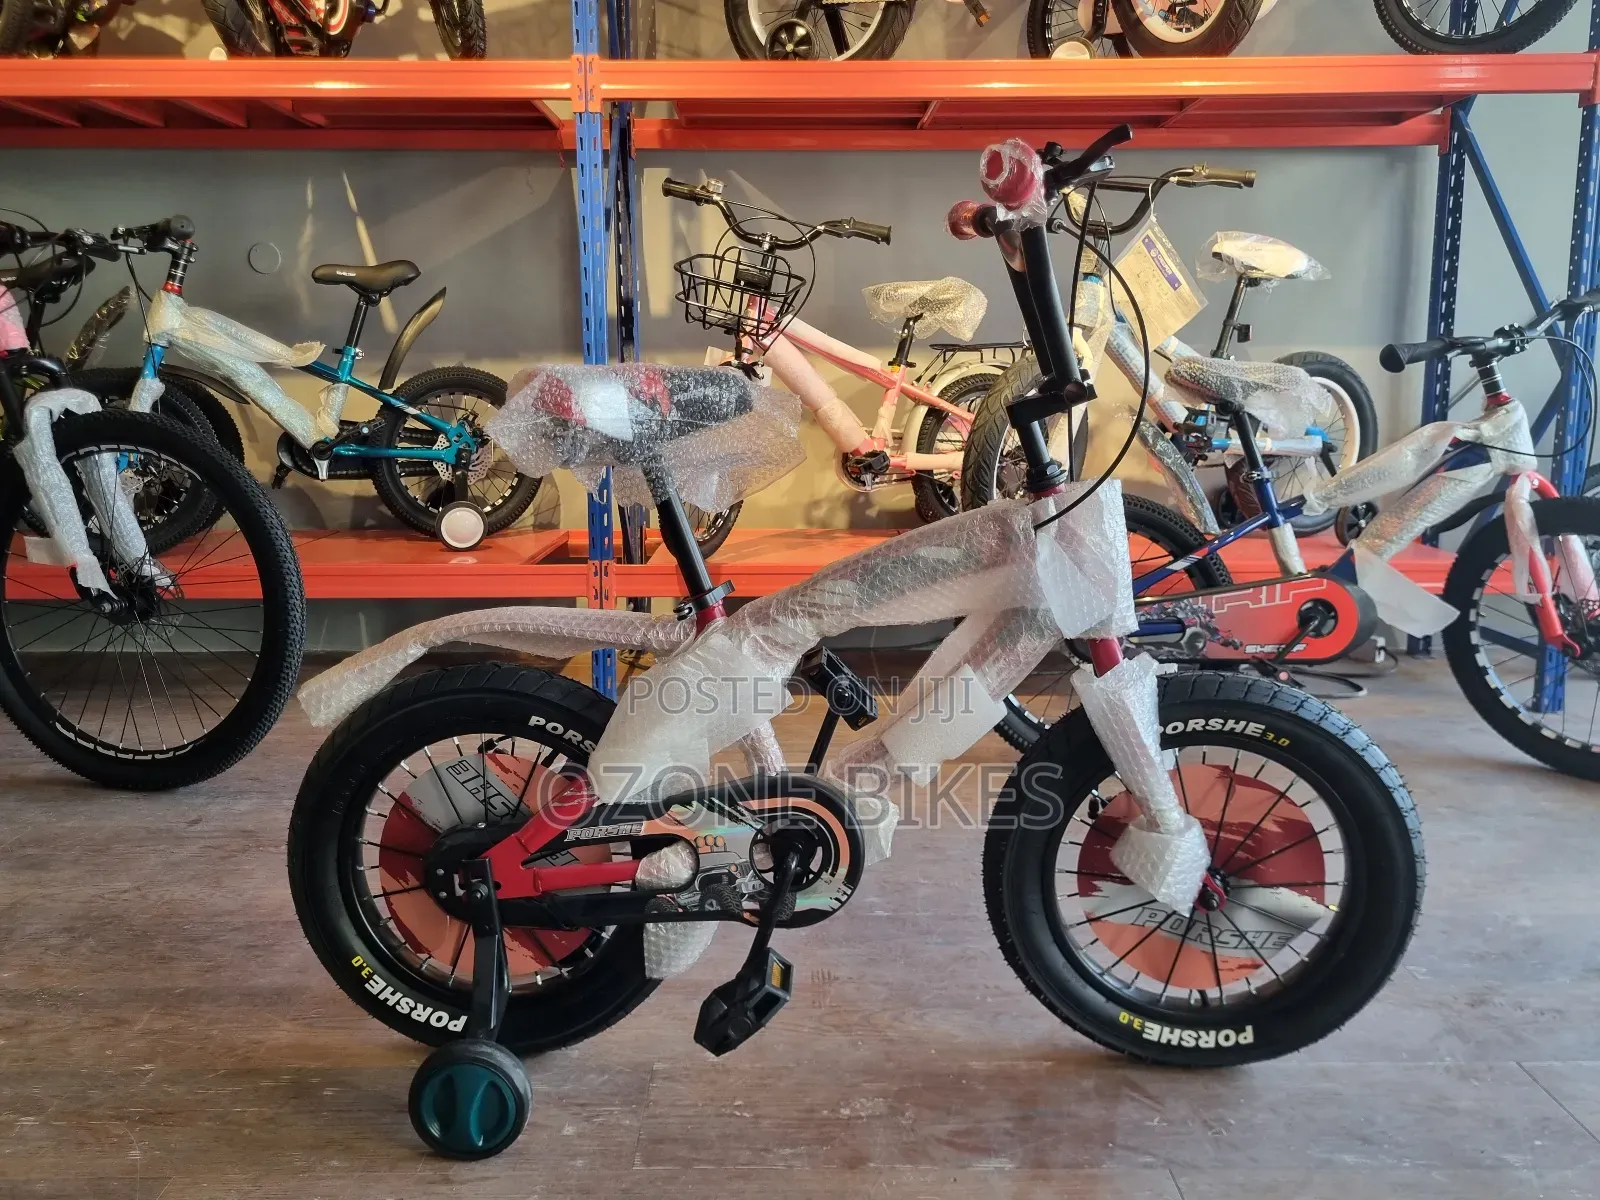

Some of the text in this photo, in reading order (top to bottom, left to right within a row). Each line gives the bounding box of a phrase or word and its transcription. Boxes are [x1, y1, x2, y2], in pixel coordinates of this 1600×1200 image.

[1262, 731, 1291, 747] 3.0
[563, 822, 644, 843] PORSHE
[1131, 906, 1296, 950] PORSHE
[351, 955, 468, 1032] PORSHE 3.0
[1118, 1011, 1254, 1048] PORSHE 3.0
